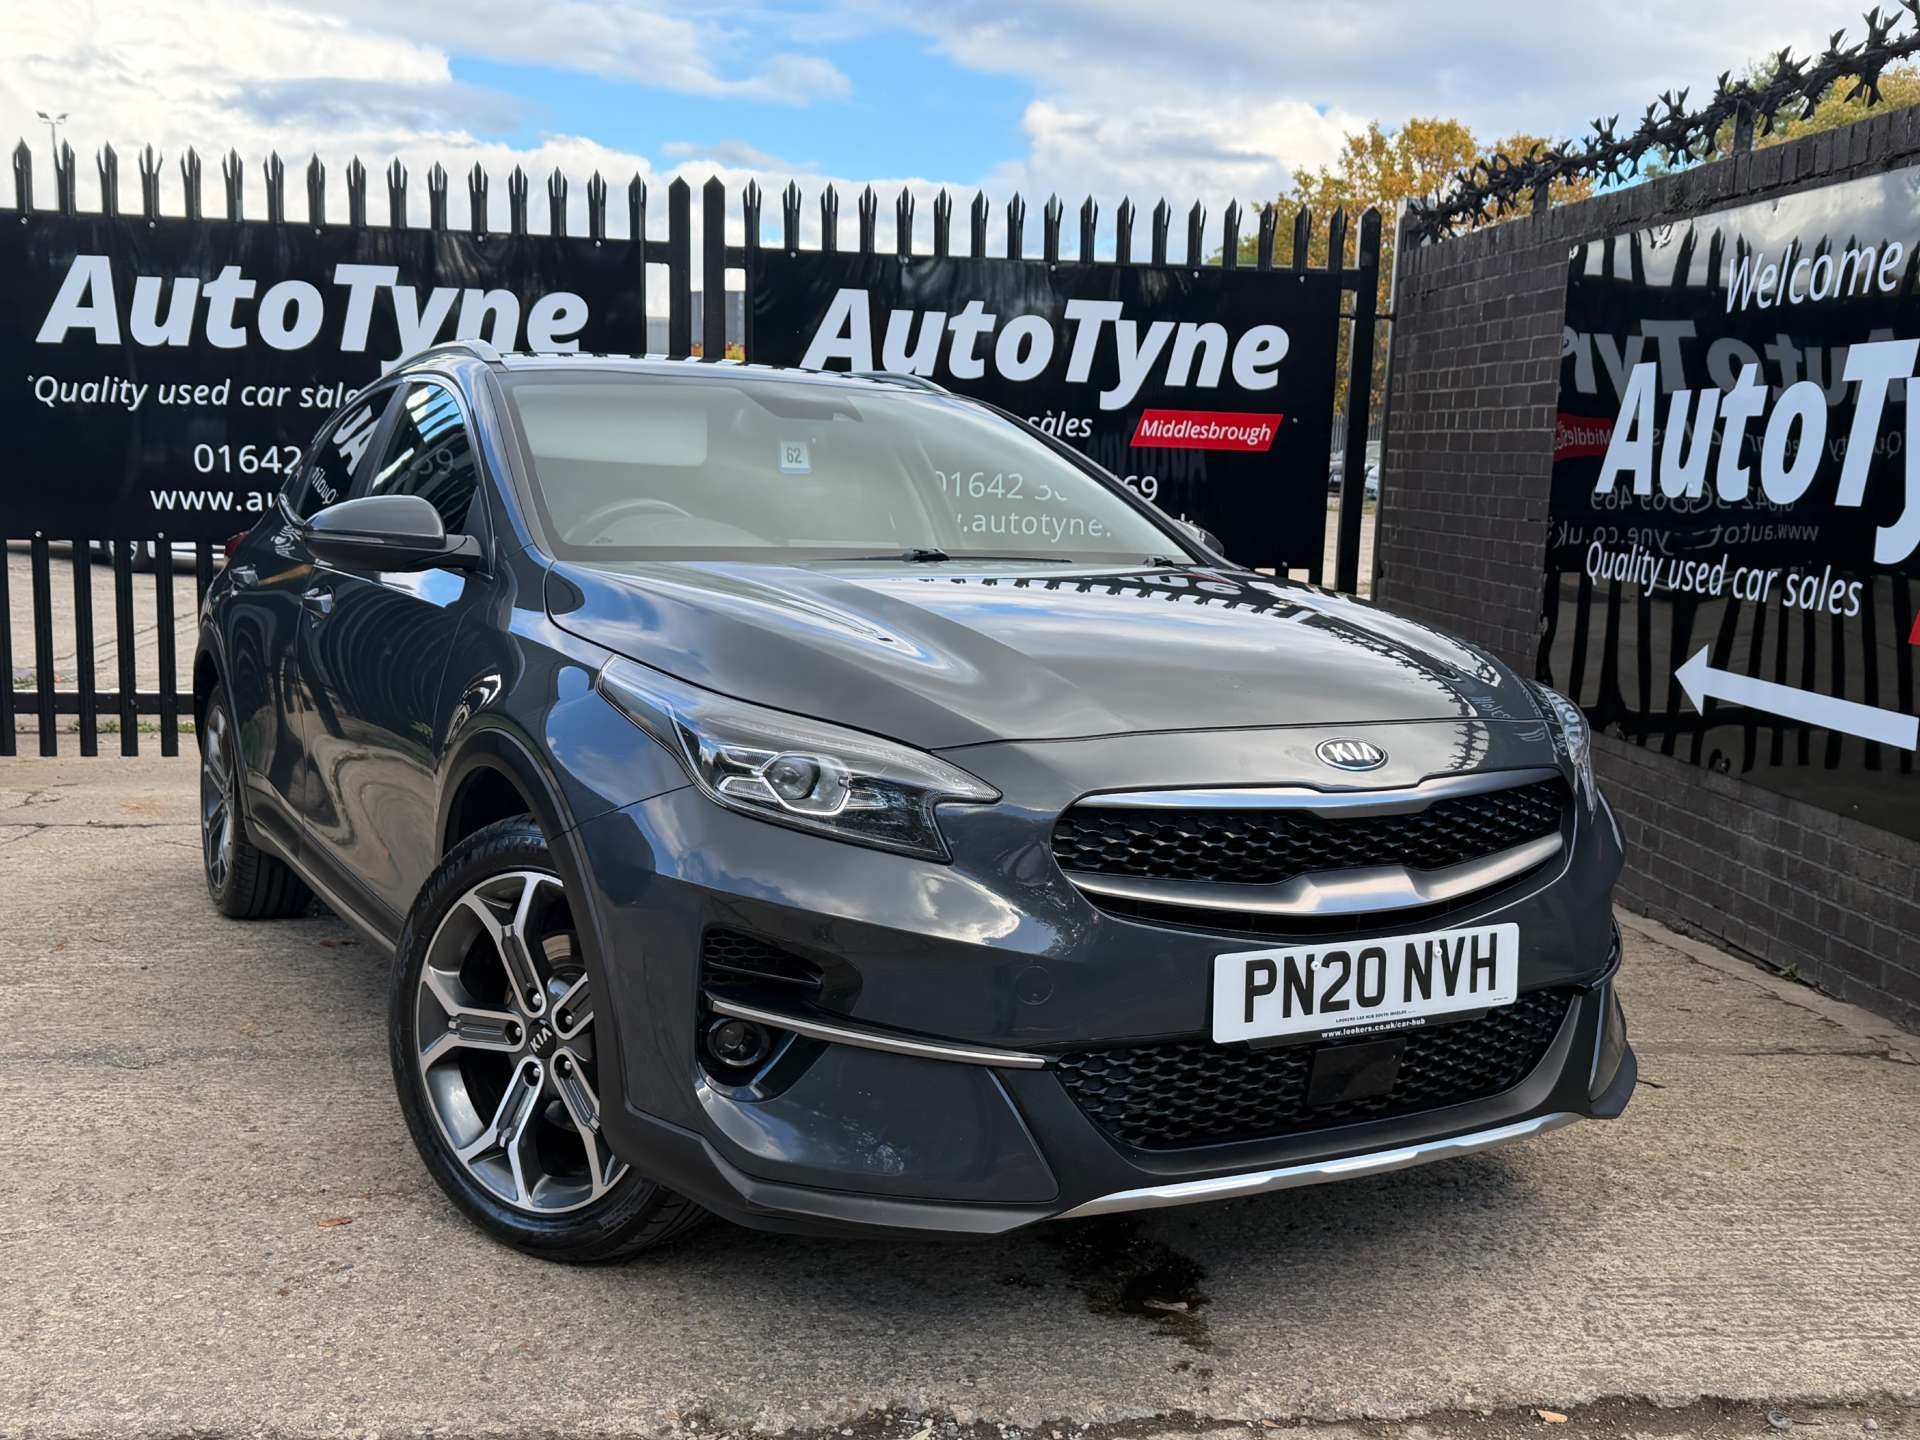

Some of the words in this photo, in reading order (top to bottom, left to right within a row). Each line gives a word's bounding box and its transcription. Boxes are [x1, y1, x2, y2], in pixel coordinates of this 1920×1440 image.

[1727, 241, 1904, 313] Welcome
[35, 254, 590, 376] AutoTyne
[800, 288, 1290, 410] AutoTyne
[34, 375, 149, 411] Quality
[157, 378, 231, 406] used
[240, 384, 292, 408] car
[1140, 419, 1272, 446] Middlesbrough
[193, 443, 302, 475] 01642
[786, 447, 803, 464] 62
[1585, 541, 1664, 598] Quality
[1667, 553, 1729, 596] used
[1732, 565, 1779, 602] car
[1782, 564, 1864, 617] sales
[1325, 740, 1383, 763] KIA
[1244, 946, 1388, 1024] PN20
[1403, 932, 1499, 1003] NVH
[530, 1026, 553, 1053] KIA
